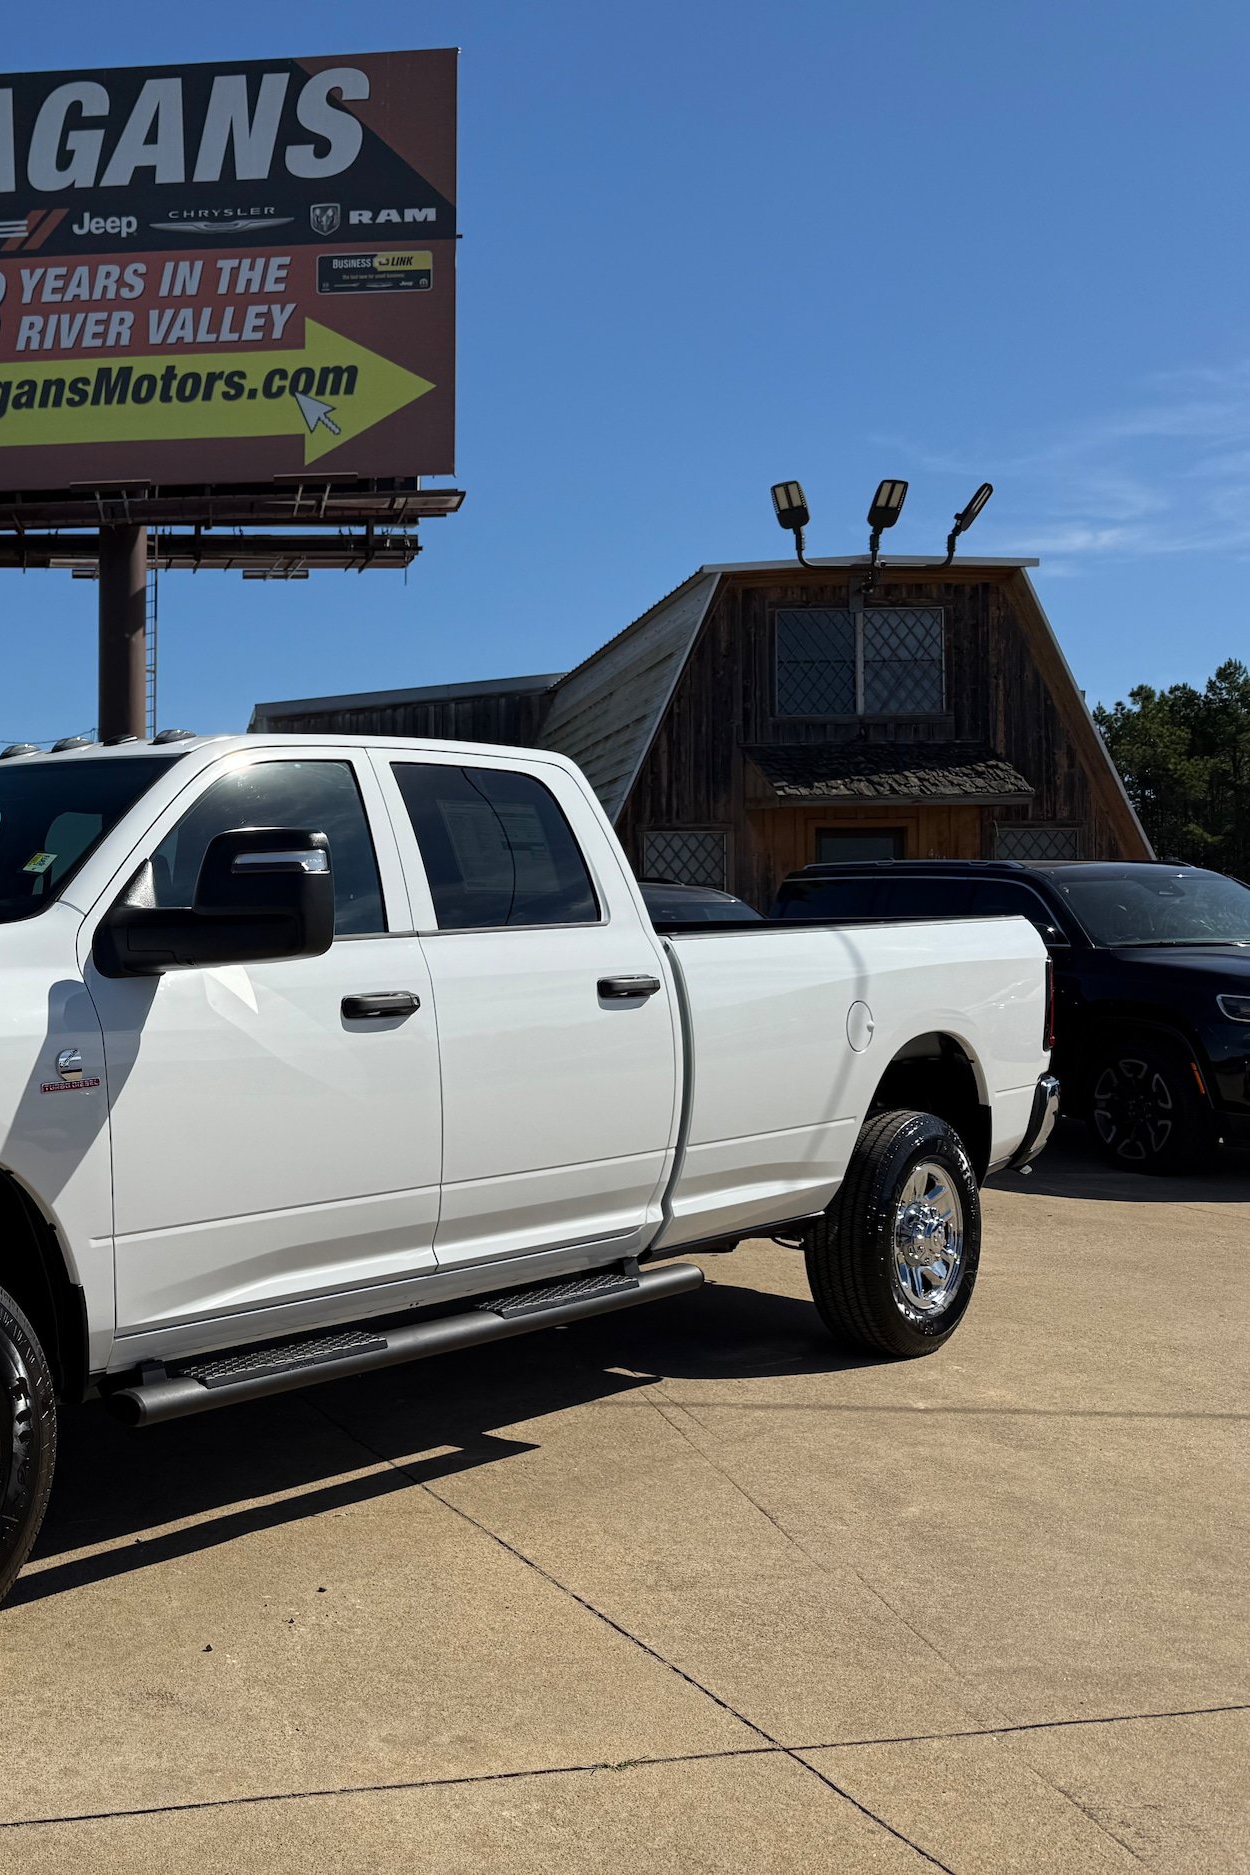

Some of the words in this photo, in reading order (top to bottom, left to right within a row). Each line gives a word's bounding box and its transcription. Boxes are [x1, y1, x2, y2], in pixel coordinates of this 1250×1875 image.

[168, 206, 275, 219] CHRYSLER
[349, 207, 436, 223] RAM
[72, 211, 137, 238] Jeep
[390, 256, 414, 266] LINK
[20, 263, 147, 305] YEARS
[158, 260, 202, 298] IN
[215, 256, 291, 295] THE
[15, 310, 135, 352] RIVER
[149, 303, 297, 345] VALLEY
